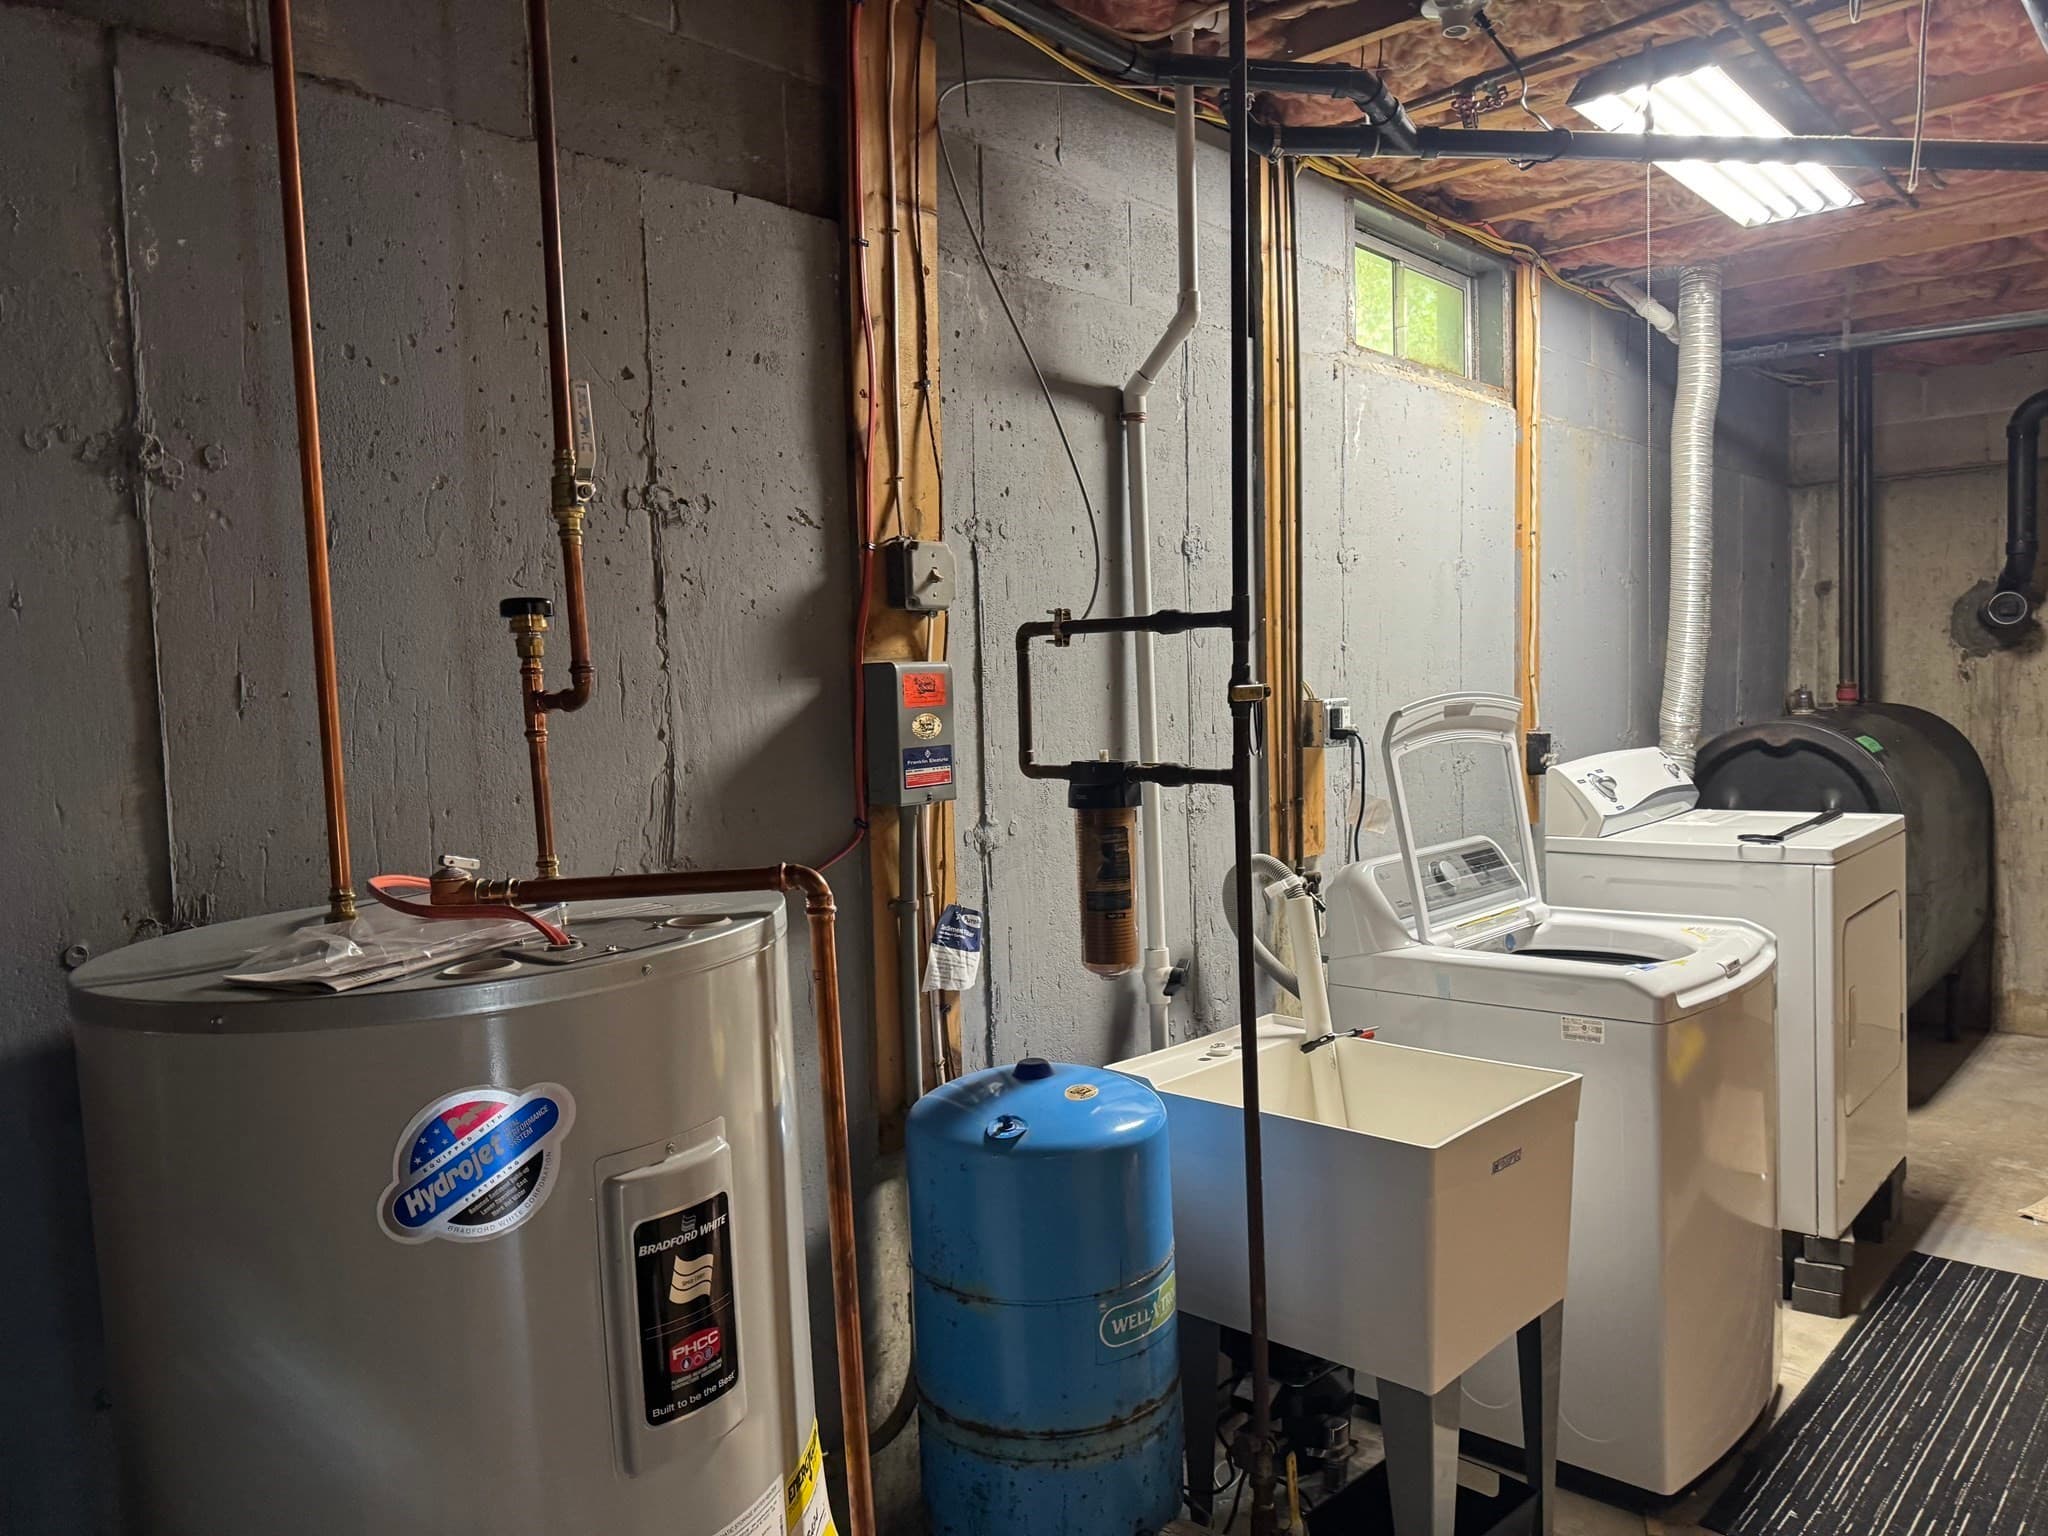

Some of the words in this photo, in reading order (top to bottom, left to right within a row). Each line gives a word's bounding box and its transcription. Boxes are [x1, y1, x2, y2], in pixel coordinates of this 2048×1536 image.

[422, 1135, 473, 1174] EQUIPPED
[479, 1114, 503, 1133] WITH
[404, 1132, 506, 1218] Hydrojet
[447, 1224, 496, 1235] BRADFORD
[524, 1151, 552, 1209] CORPORATION
[464, 1159, 520, 1202] FEATURING
[638, 1230, 698, 1257] BRADFORD
[700, 1214, 727, 1236] WHITE
[671, 1330, 718, 1360] PHCC
[652, 1403, 674, 1417] Built
[677, 1399, 688, 1408] to
[689, 1393, 702, 1403] be
[703, 1384, 717, 1396] the
[718, 1371, 735, 1388] Best
